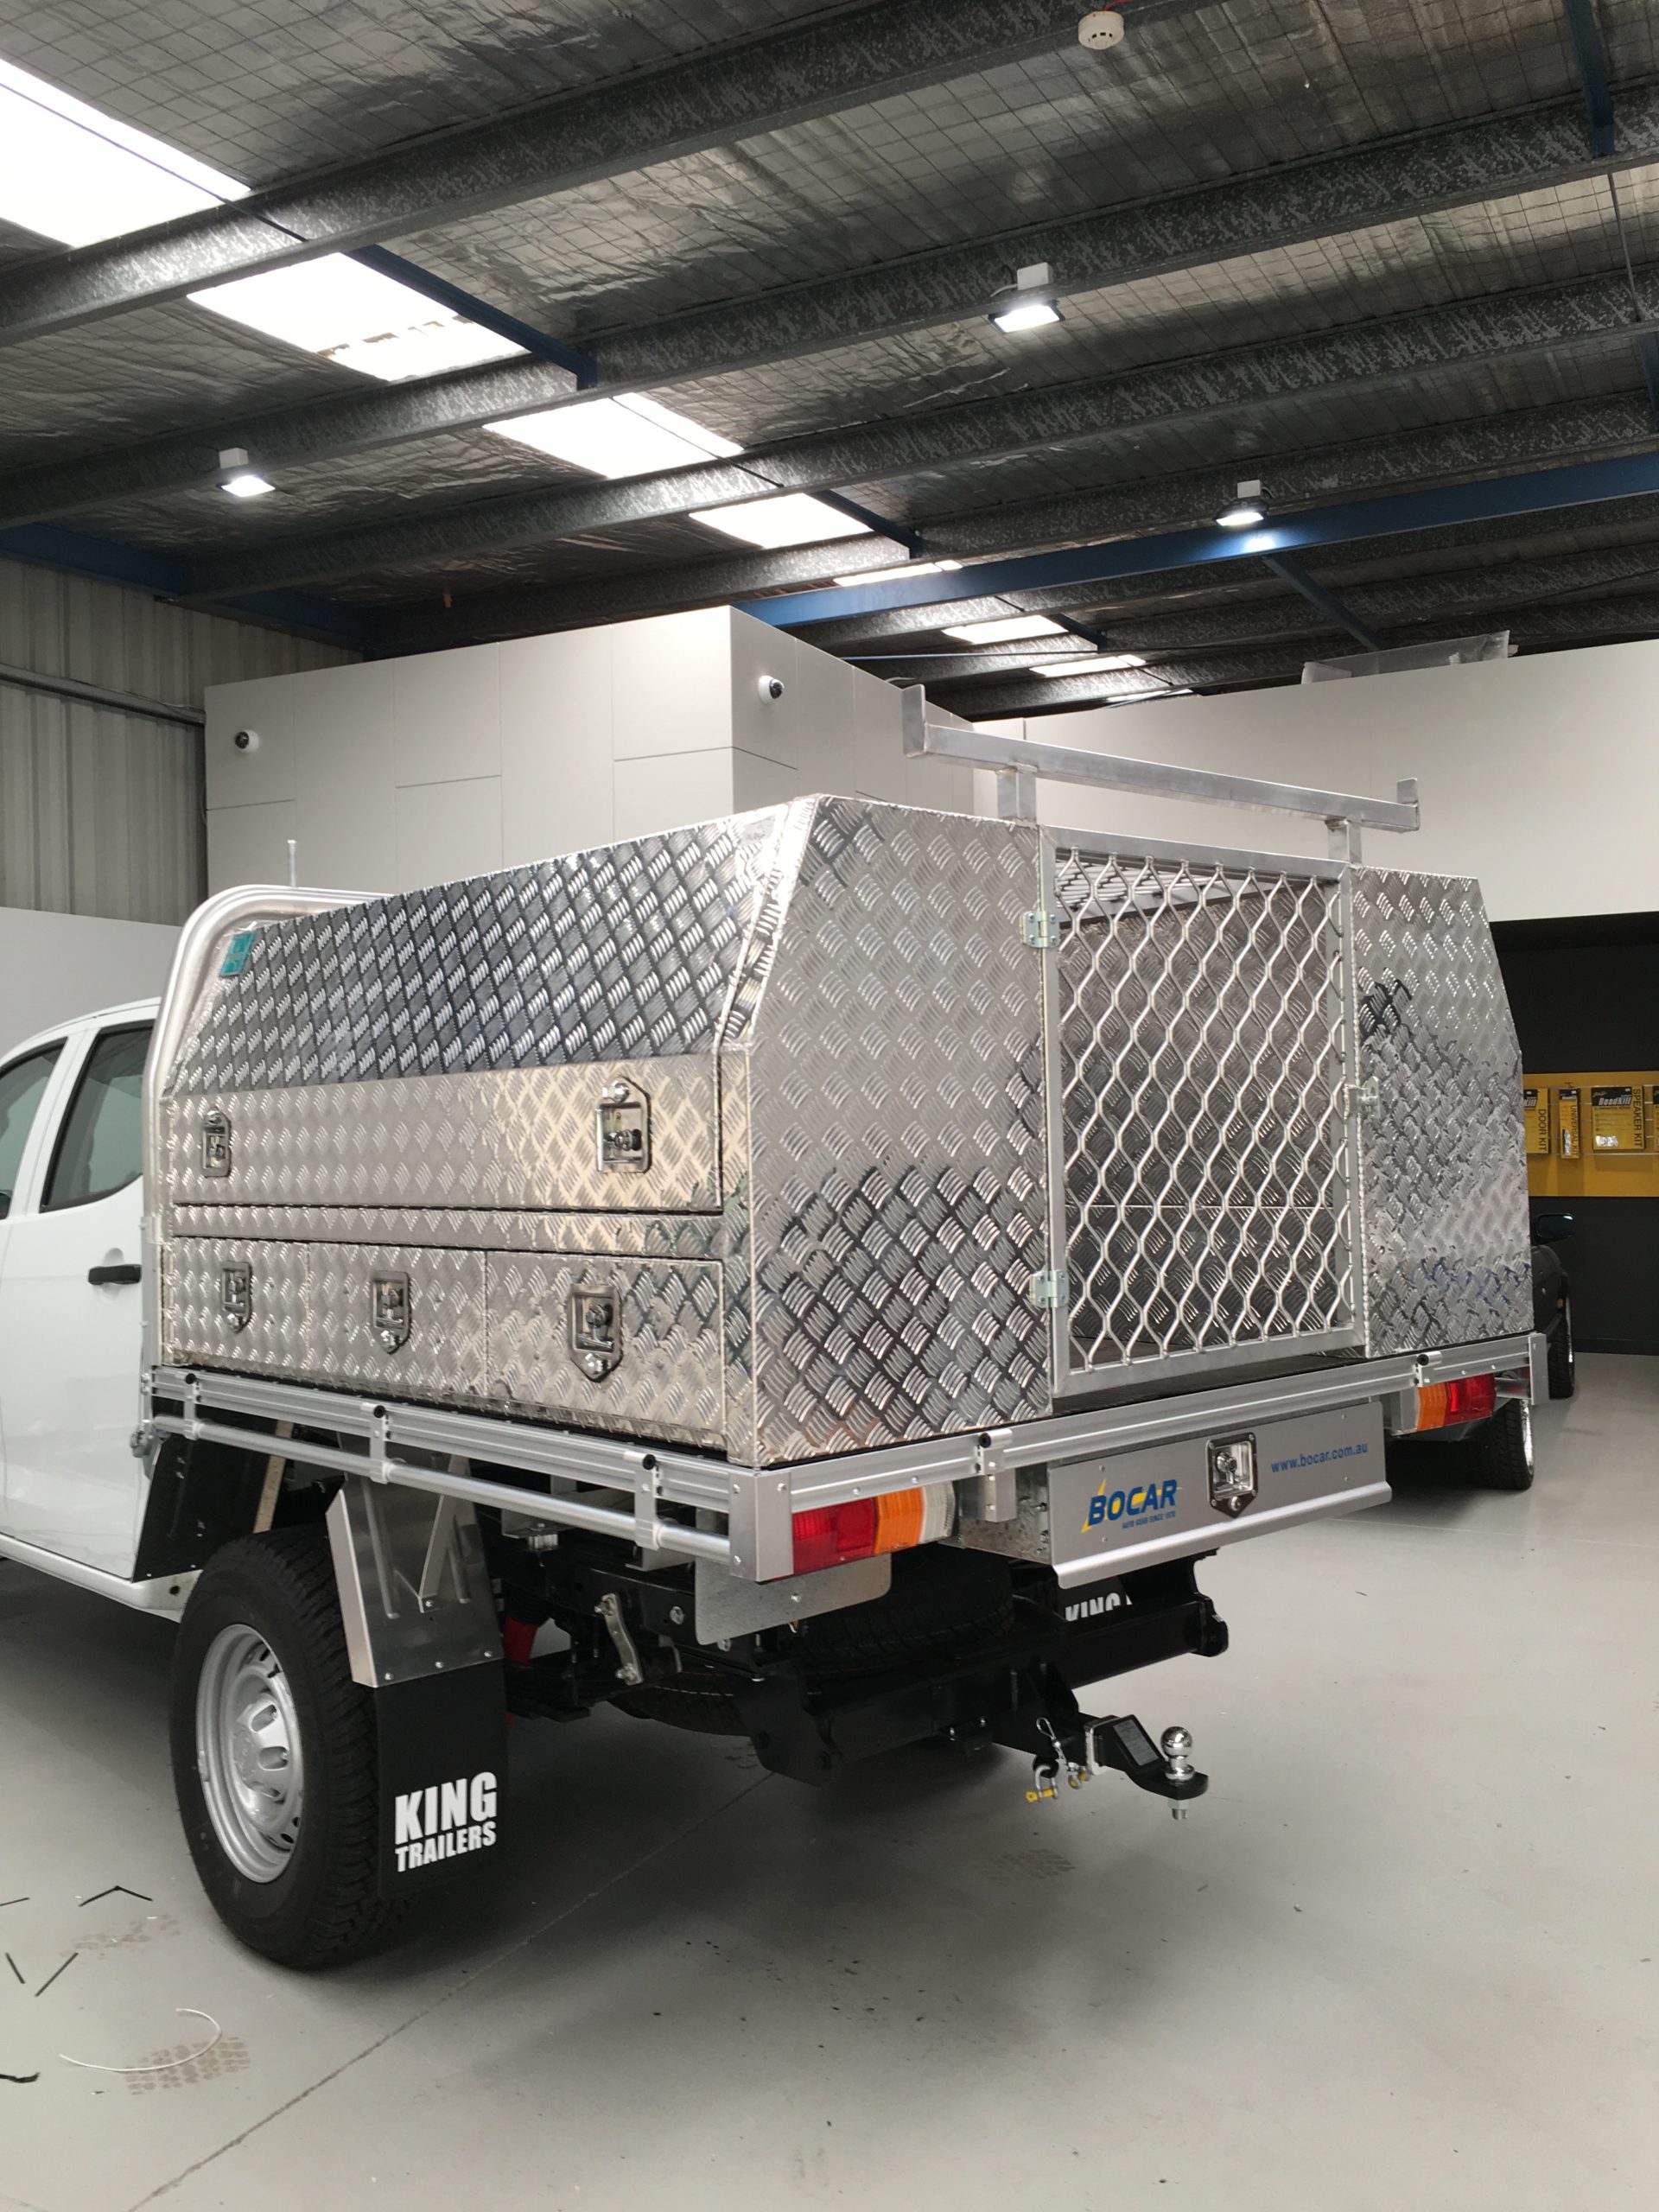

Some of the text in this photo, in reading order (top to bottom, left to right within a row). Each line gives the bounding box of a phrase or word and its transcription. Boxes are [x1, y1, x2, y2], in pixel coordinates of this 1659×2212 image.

[1538, 1109, 1547, 1151] DOOR KIT
[1633, 1089, 1643, 1147] SPEAKER KIT
[1271, 1443, 1368, 1472] www.bocar.com.au
[1088, 1478, 1177, 1526] BOCAR
[395, 1771, 497, 1845] KING
[395, 1821, 497, 1872] TRAILERS
